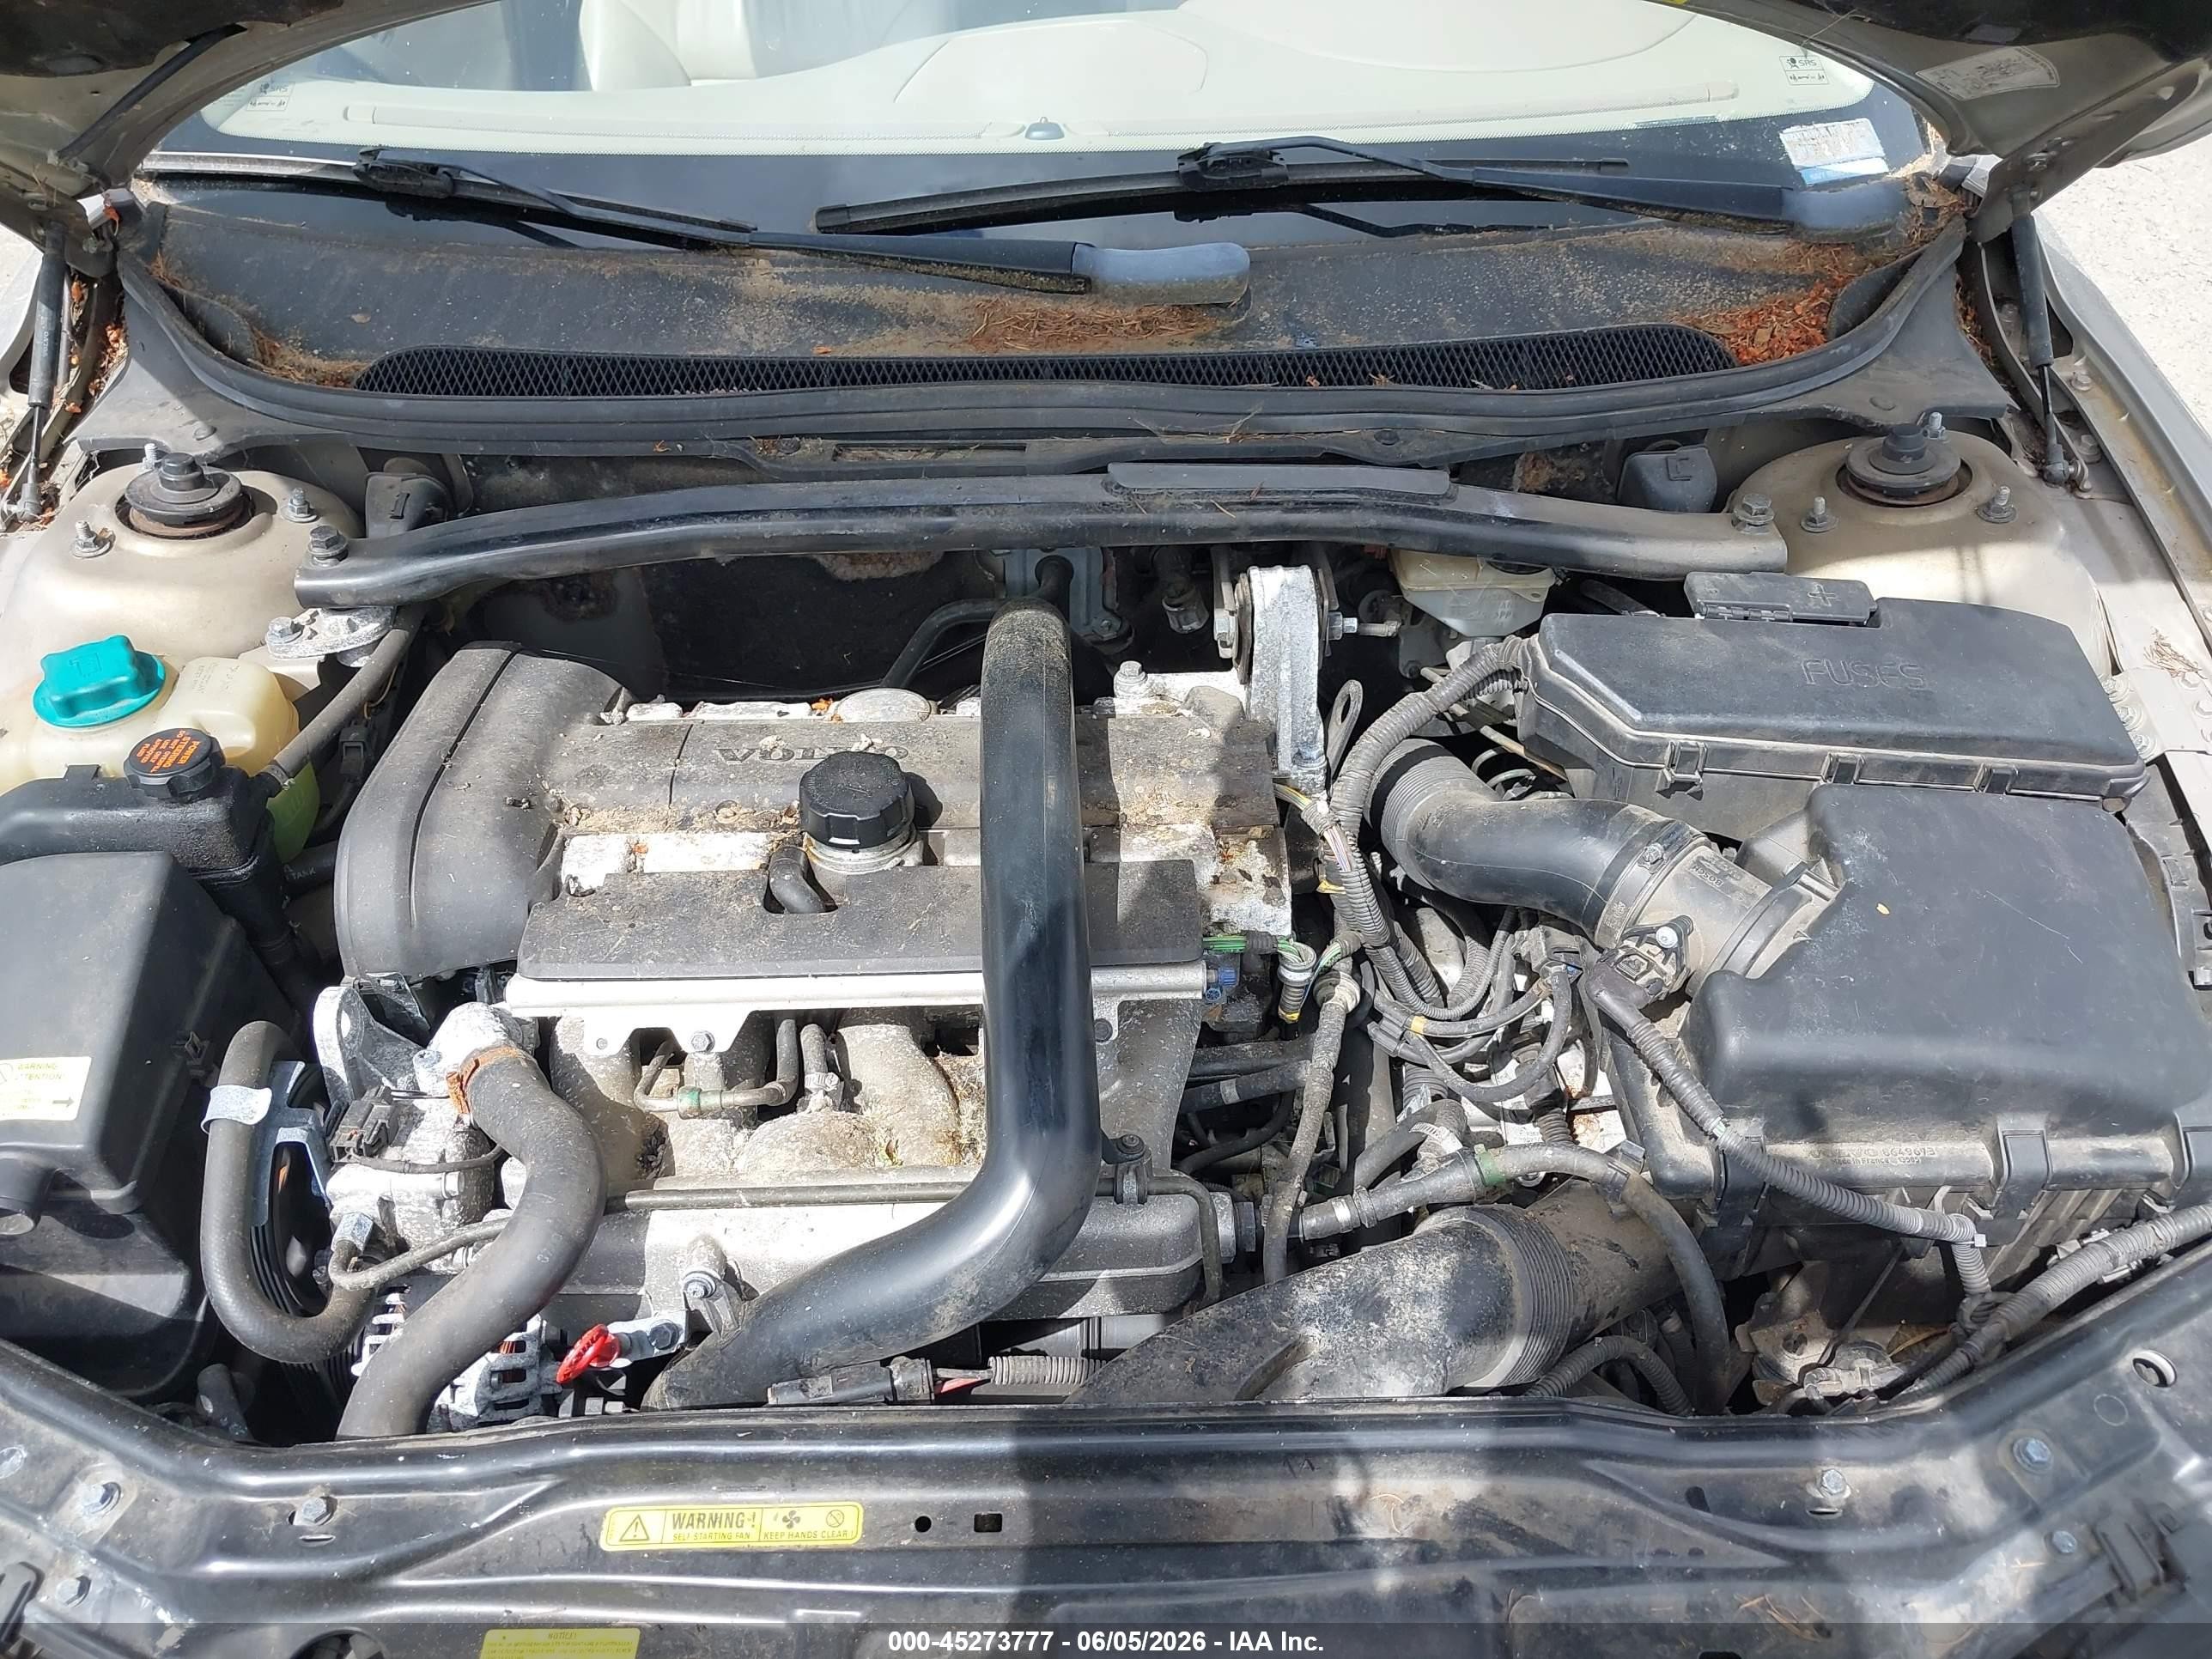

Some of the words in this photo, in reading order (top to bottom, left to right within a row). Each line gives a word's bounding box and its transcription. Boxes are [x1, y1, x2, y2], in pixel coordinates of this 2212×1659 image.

[1801, 659, 1924, 690] FUSES
[177, 740, 202, 764] POWER
[1692, 865, 1724, 887] BOSCH
